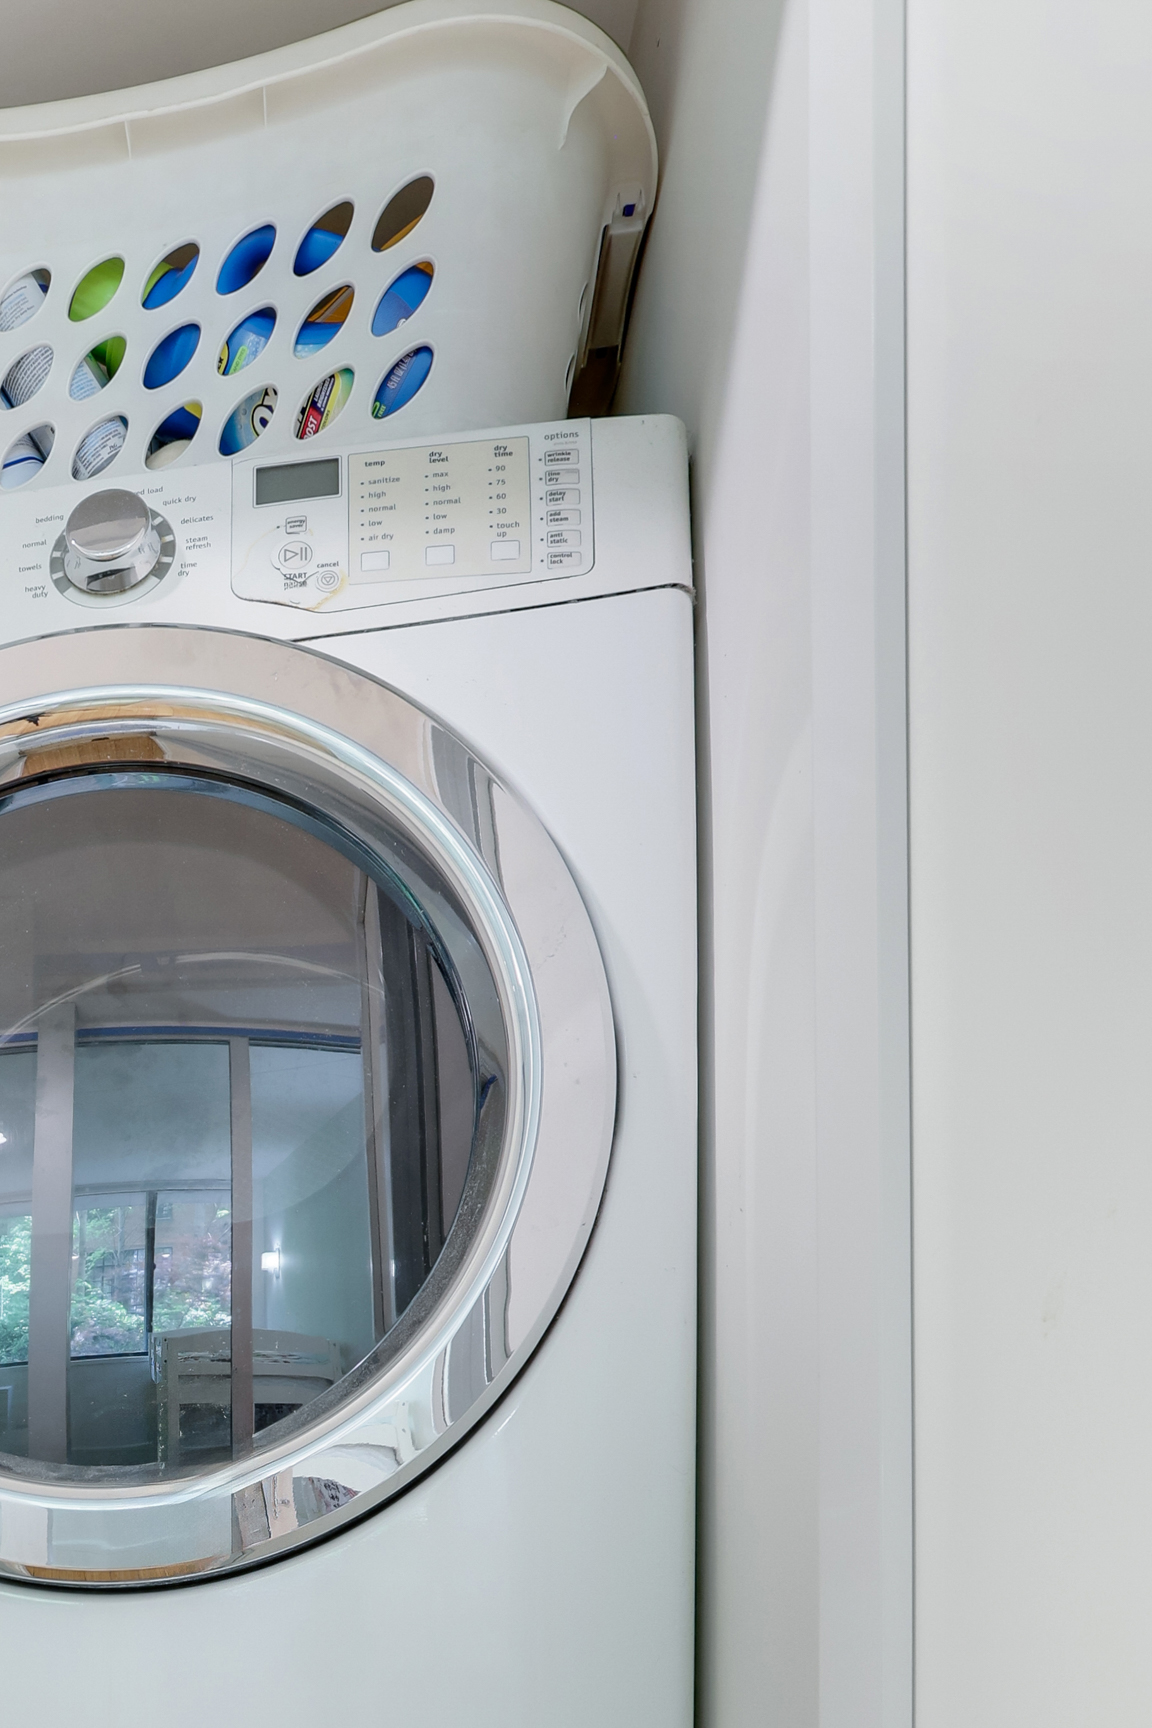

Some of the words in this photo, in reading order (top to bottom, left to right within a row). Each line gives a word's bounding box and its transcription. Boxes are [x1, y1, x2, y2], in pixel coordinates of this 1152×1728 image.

[544, 430, 579, 441] options
[493, 444, 508, 452] dry
[494, 450, 513, 458] time
[429, 456, 449, 464] level
[368, 476, 401, 485] sanitize
[148, 486, 164, 494] load
[432, 484, 451, 492] high
[368, 491, 387, 499] high
[496, 492, 507, 500] 60
[548, 490, 566, 498] delay
[162, 497, 182, 506] quick
[184, 495, 197, 503] dry
[433, 497, 461, 506] normal
[368, 504, 396, 513] normal
[35, 514, 64, 524] bedding
[180, 515, 214, 524] delicates
[496, 521, 520, 529] touch
[433, 527, 455, 535] damp
[381, 533, 394, 541] dry
[22, 539, 47, 549] normal
[185, 541, 211, 550] refresh
[18, 563, 42, 573] towels
[177, 569, 190, 577] dry
[283, 572, 307, 580] START
[24, 585, 46, 593] heavy
[32, 590, 49, 599] duty
